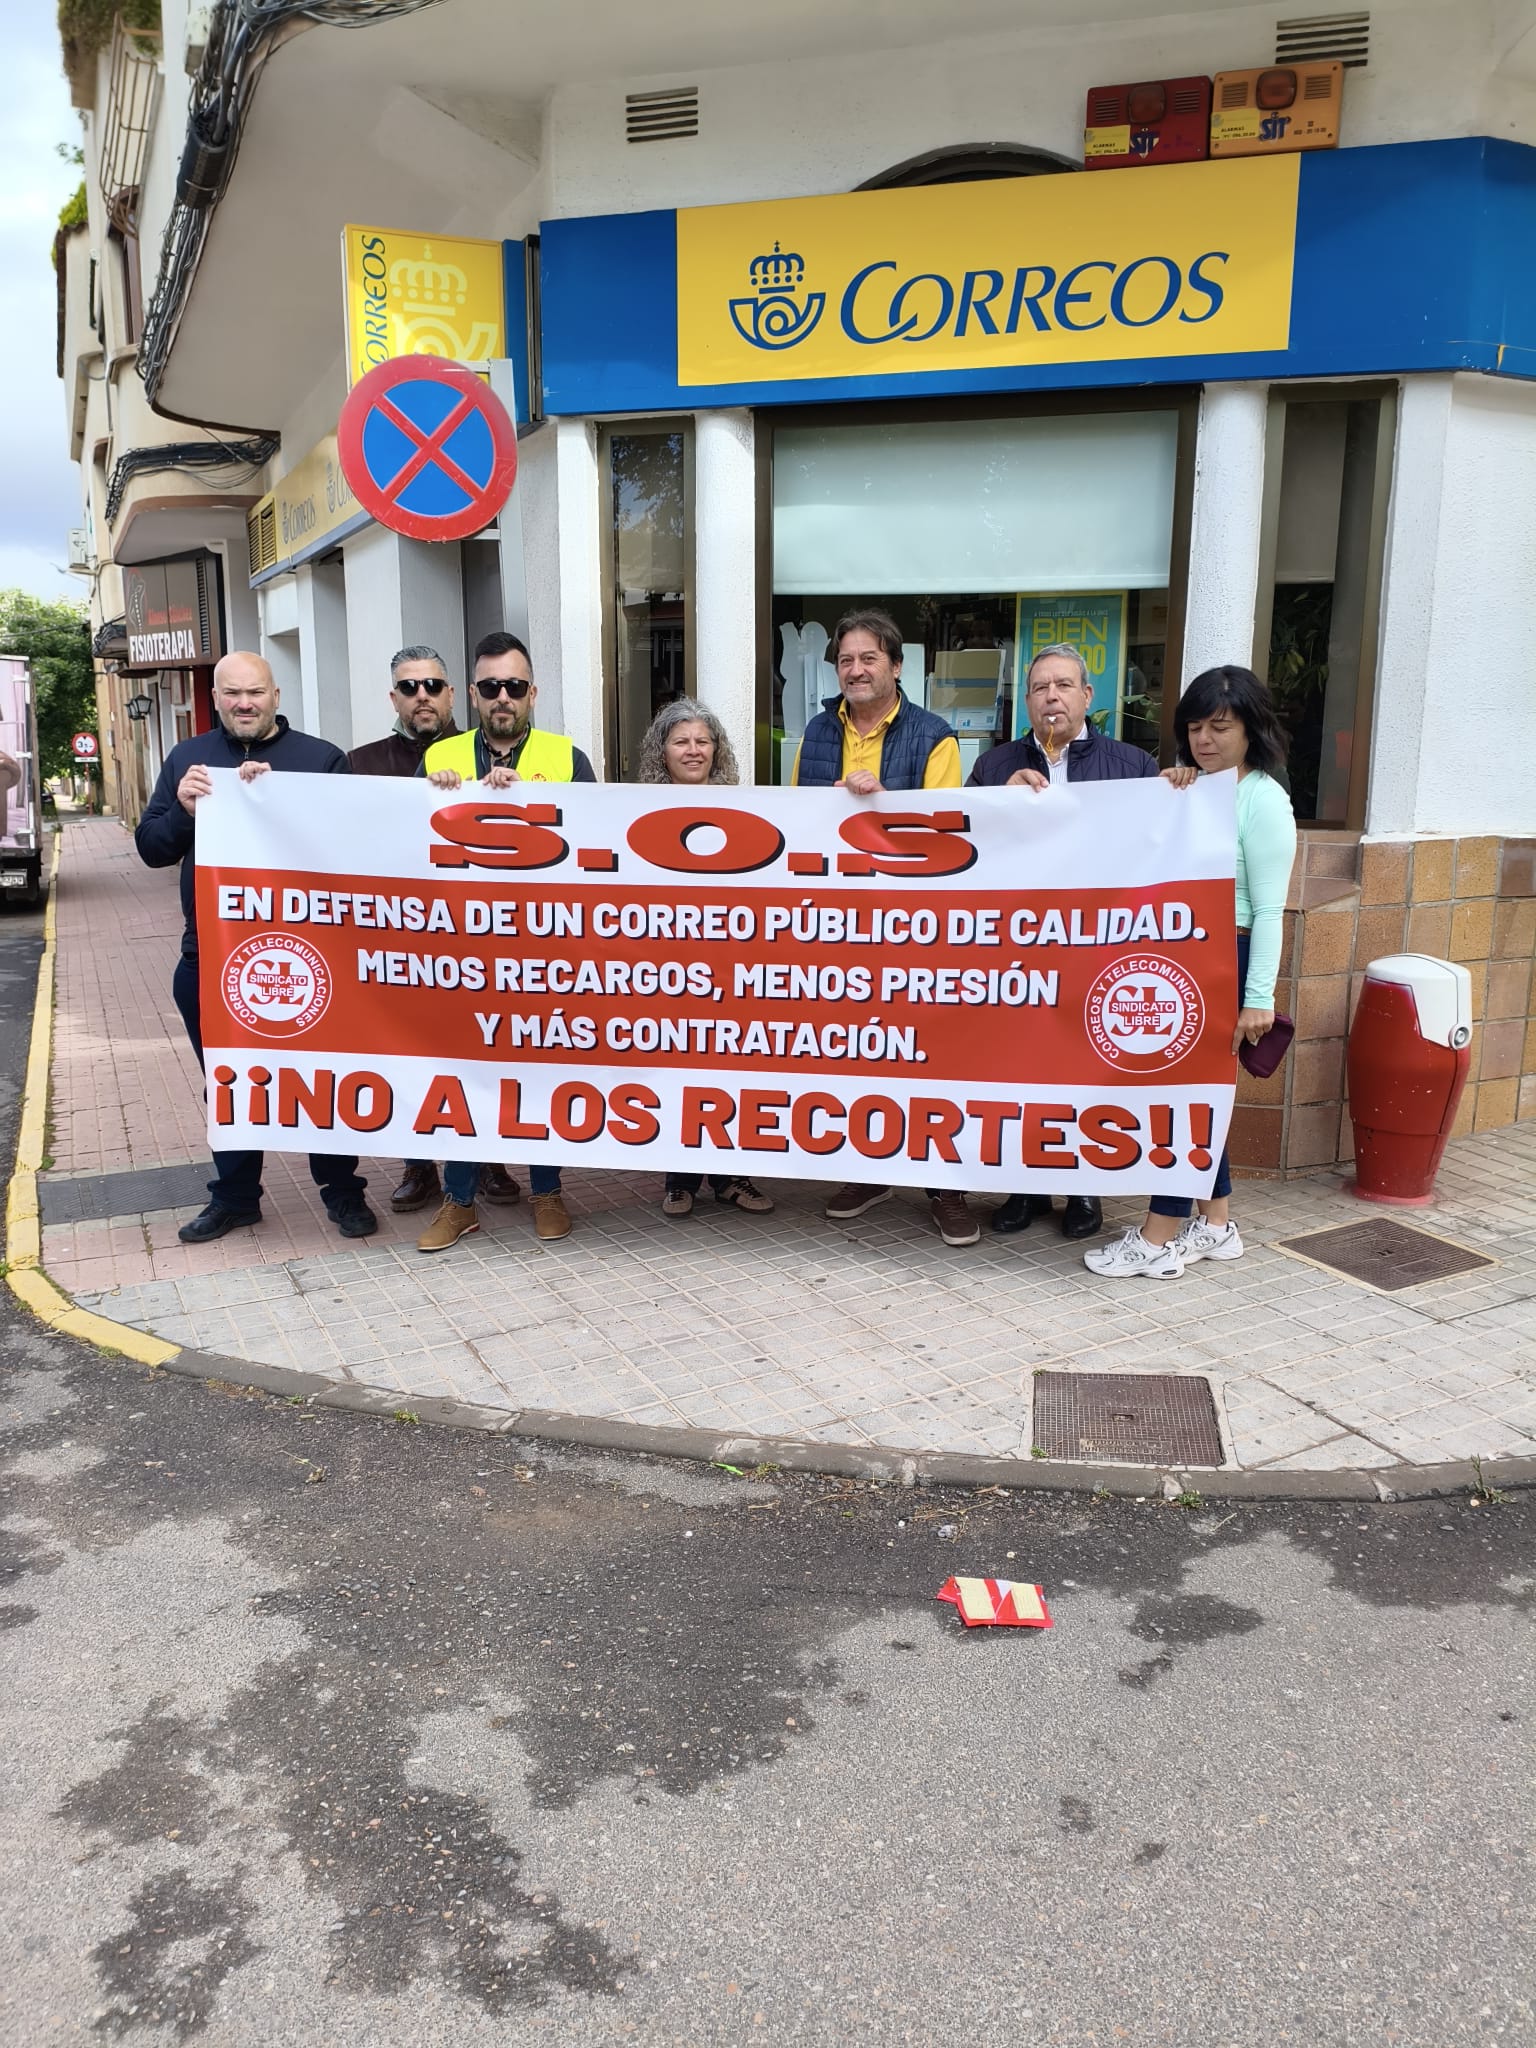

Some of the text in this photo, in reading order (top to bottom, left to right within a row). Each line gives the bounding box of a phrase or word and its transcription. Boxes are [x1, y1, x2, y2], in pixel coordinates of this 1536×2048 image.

[129, 629, 196, 662] FISIOTERAPIA
[1032, 616, 1108, 644] BIEN
[218, 884, 1208, 948] EN DEFENSA DE UN CORREO PÚBLICO DE CALIDAD.
[227, 937, 327, 1027] CORREOS Y TELECOMUNICACIONES
[249, 974, 308, 985] SINDICATO
[262, 986, 294, 997] LIBRE
[357, 948, 1060, 1008] MENOS RECARGOS, MENOS PRESIÓN
[1090, 959, 1198, 1059] CORREOS Y TELECOMUNICACIONES
[1111, 1002, 1175, 1012] SINDICATO
[1124, 1015, 1160, 1026] LIBRE
[475, 1008, 927, 1064] Y MÁS CONTRATACIÓN.
[213, 1064, 1215, 1171] ¡¡NO A LOS RECORTES!!
